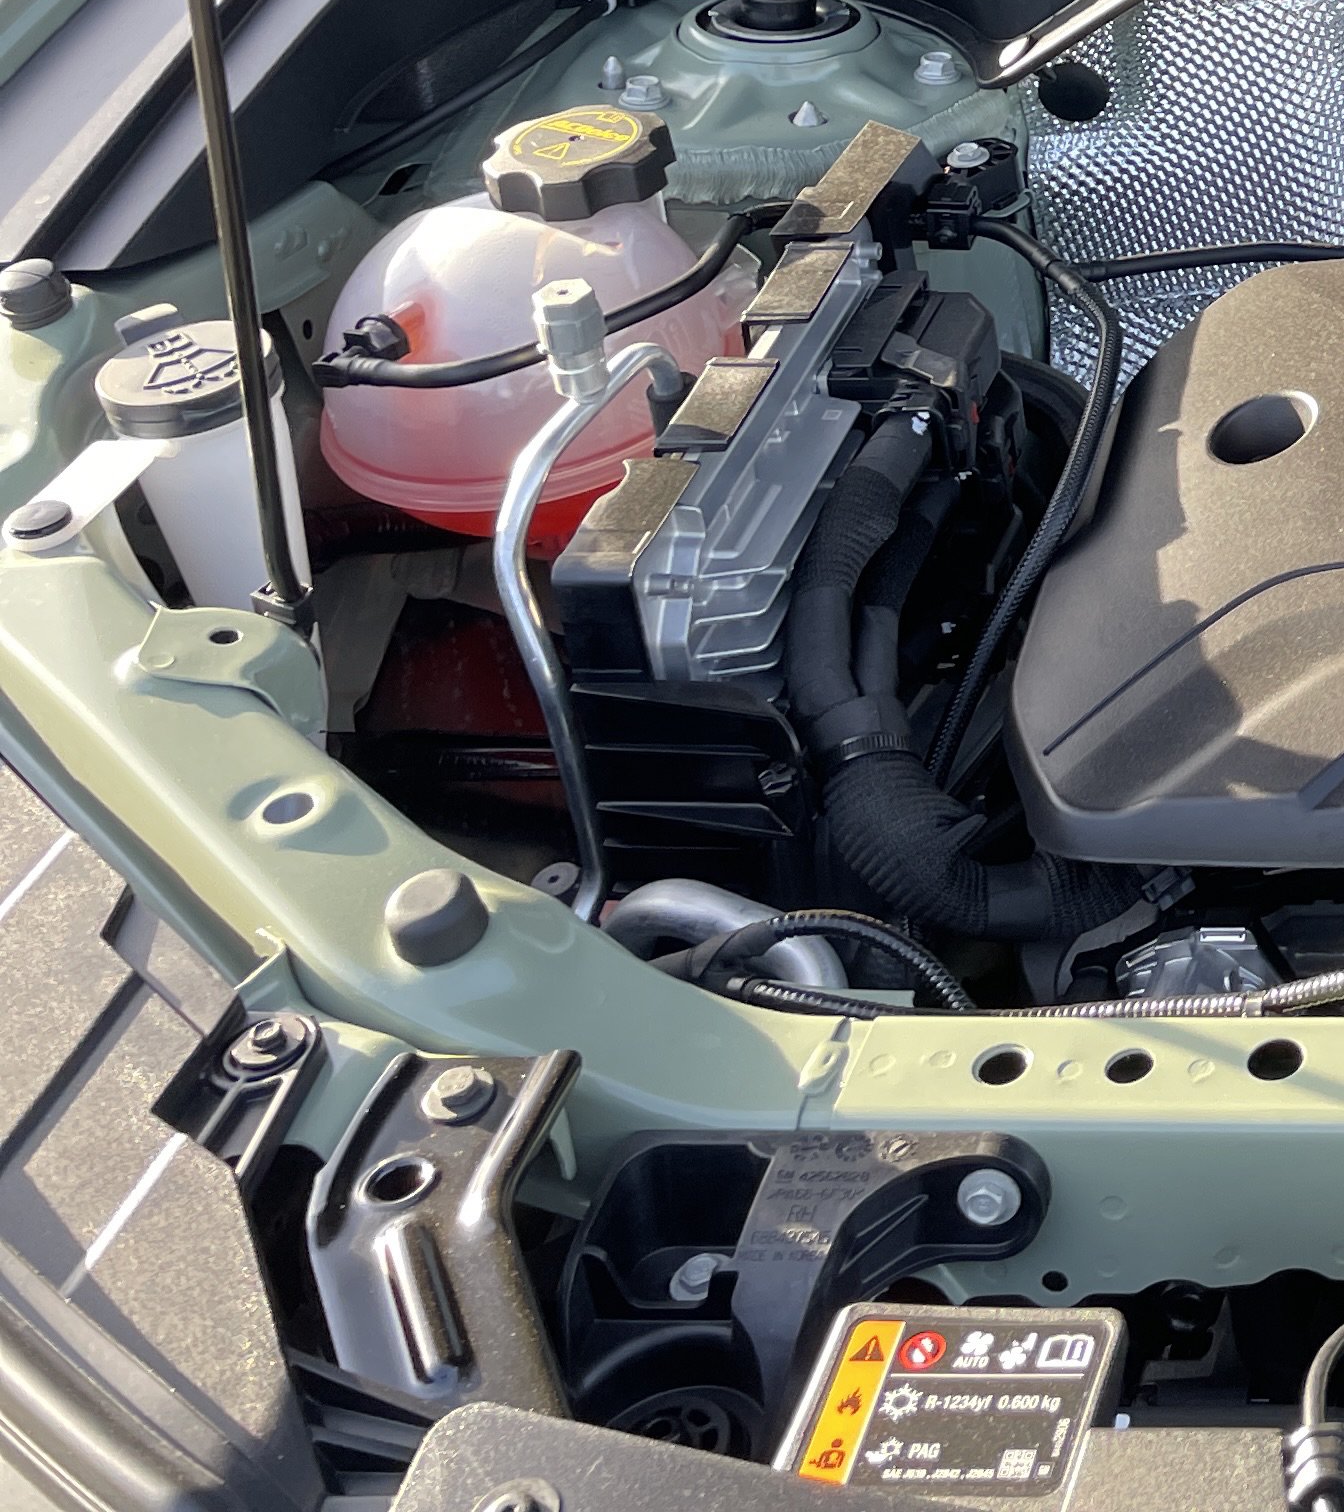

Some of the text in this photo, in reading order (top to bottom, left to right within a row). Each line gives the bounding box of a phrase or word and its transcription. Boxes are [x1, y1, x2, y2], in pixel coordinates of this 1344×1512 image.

[952, 1355, 990, 1369] AUTO
[924, 1394, 1062, 1414] R-1234yf 0.600 kg
[907, 1442, 942, 1459] PAG
